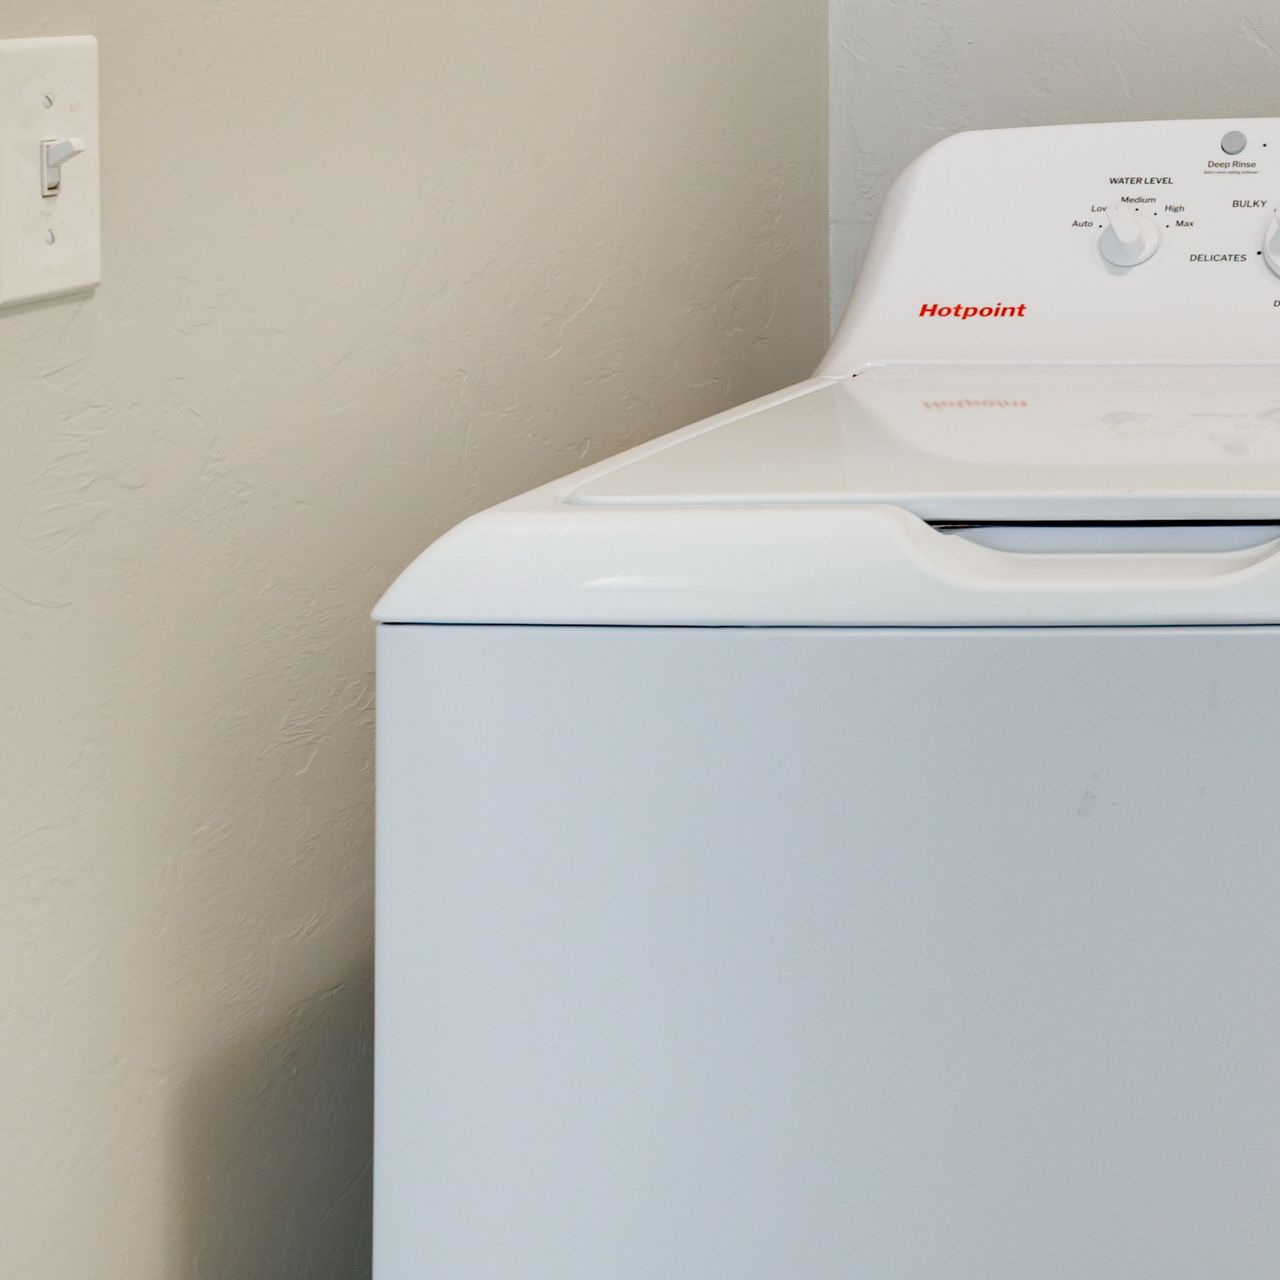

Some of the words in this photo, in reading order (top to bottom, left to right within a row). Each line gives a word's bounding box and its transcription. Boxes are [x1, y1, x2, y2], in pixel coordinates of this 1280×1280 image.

[1207, 160, 1230, 169] Deep
[1232, 160, 1256, 168] Rinse
[1109, 177, 1142, 185] WATER
[1144, 177, 1174, 185] LEVEL
[1120, 196, 1156, 204] Medium
[1232, 200, 1268, 208] BULKY
[1164, 204, 1185, 213] High
[1072, 220, 1094, 228] Auto
[1176, 220, 1194, 228] Max
[1189, 254, 1248, 262] DELICATES
[918, 302, 1027, 320] Hotpoint
